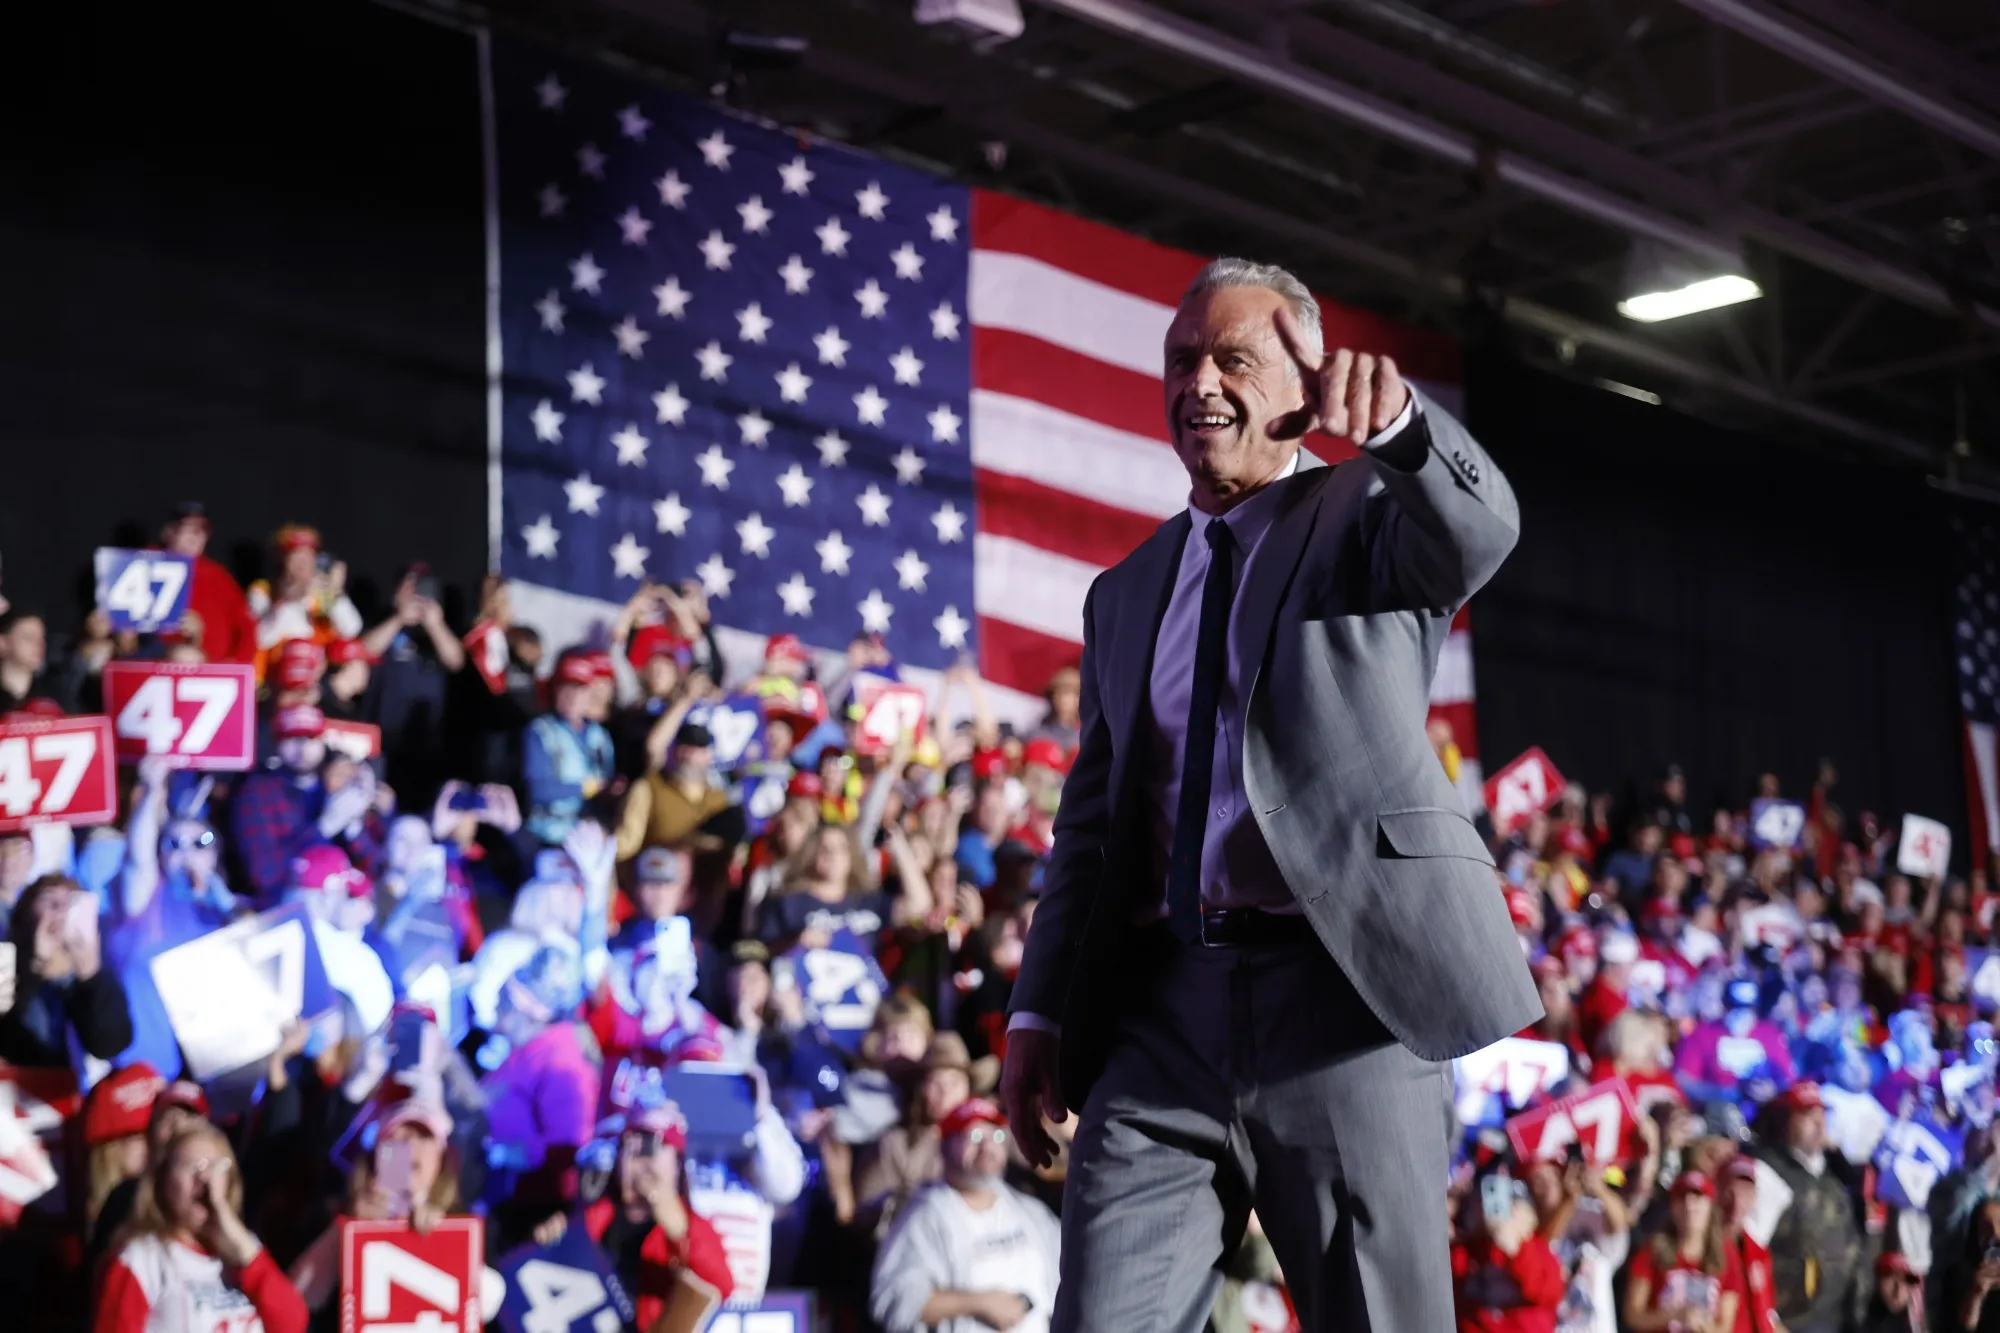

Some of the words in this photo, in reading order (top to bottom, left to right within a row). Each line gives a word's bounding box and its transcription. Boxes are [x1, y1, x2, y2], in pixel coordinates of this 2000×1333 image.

[108, 559, 188, 622] 47
[117, 675, 239, 755] 47
[864, 692, 925, 745] 47
[0, 731, 96, 817] 47
[1537, 1091, 1622, 1164] 47
[516, 1258, 621, 1333] 4
